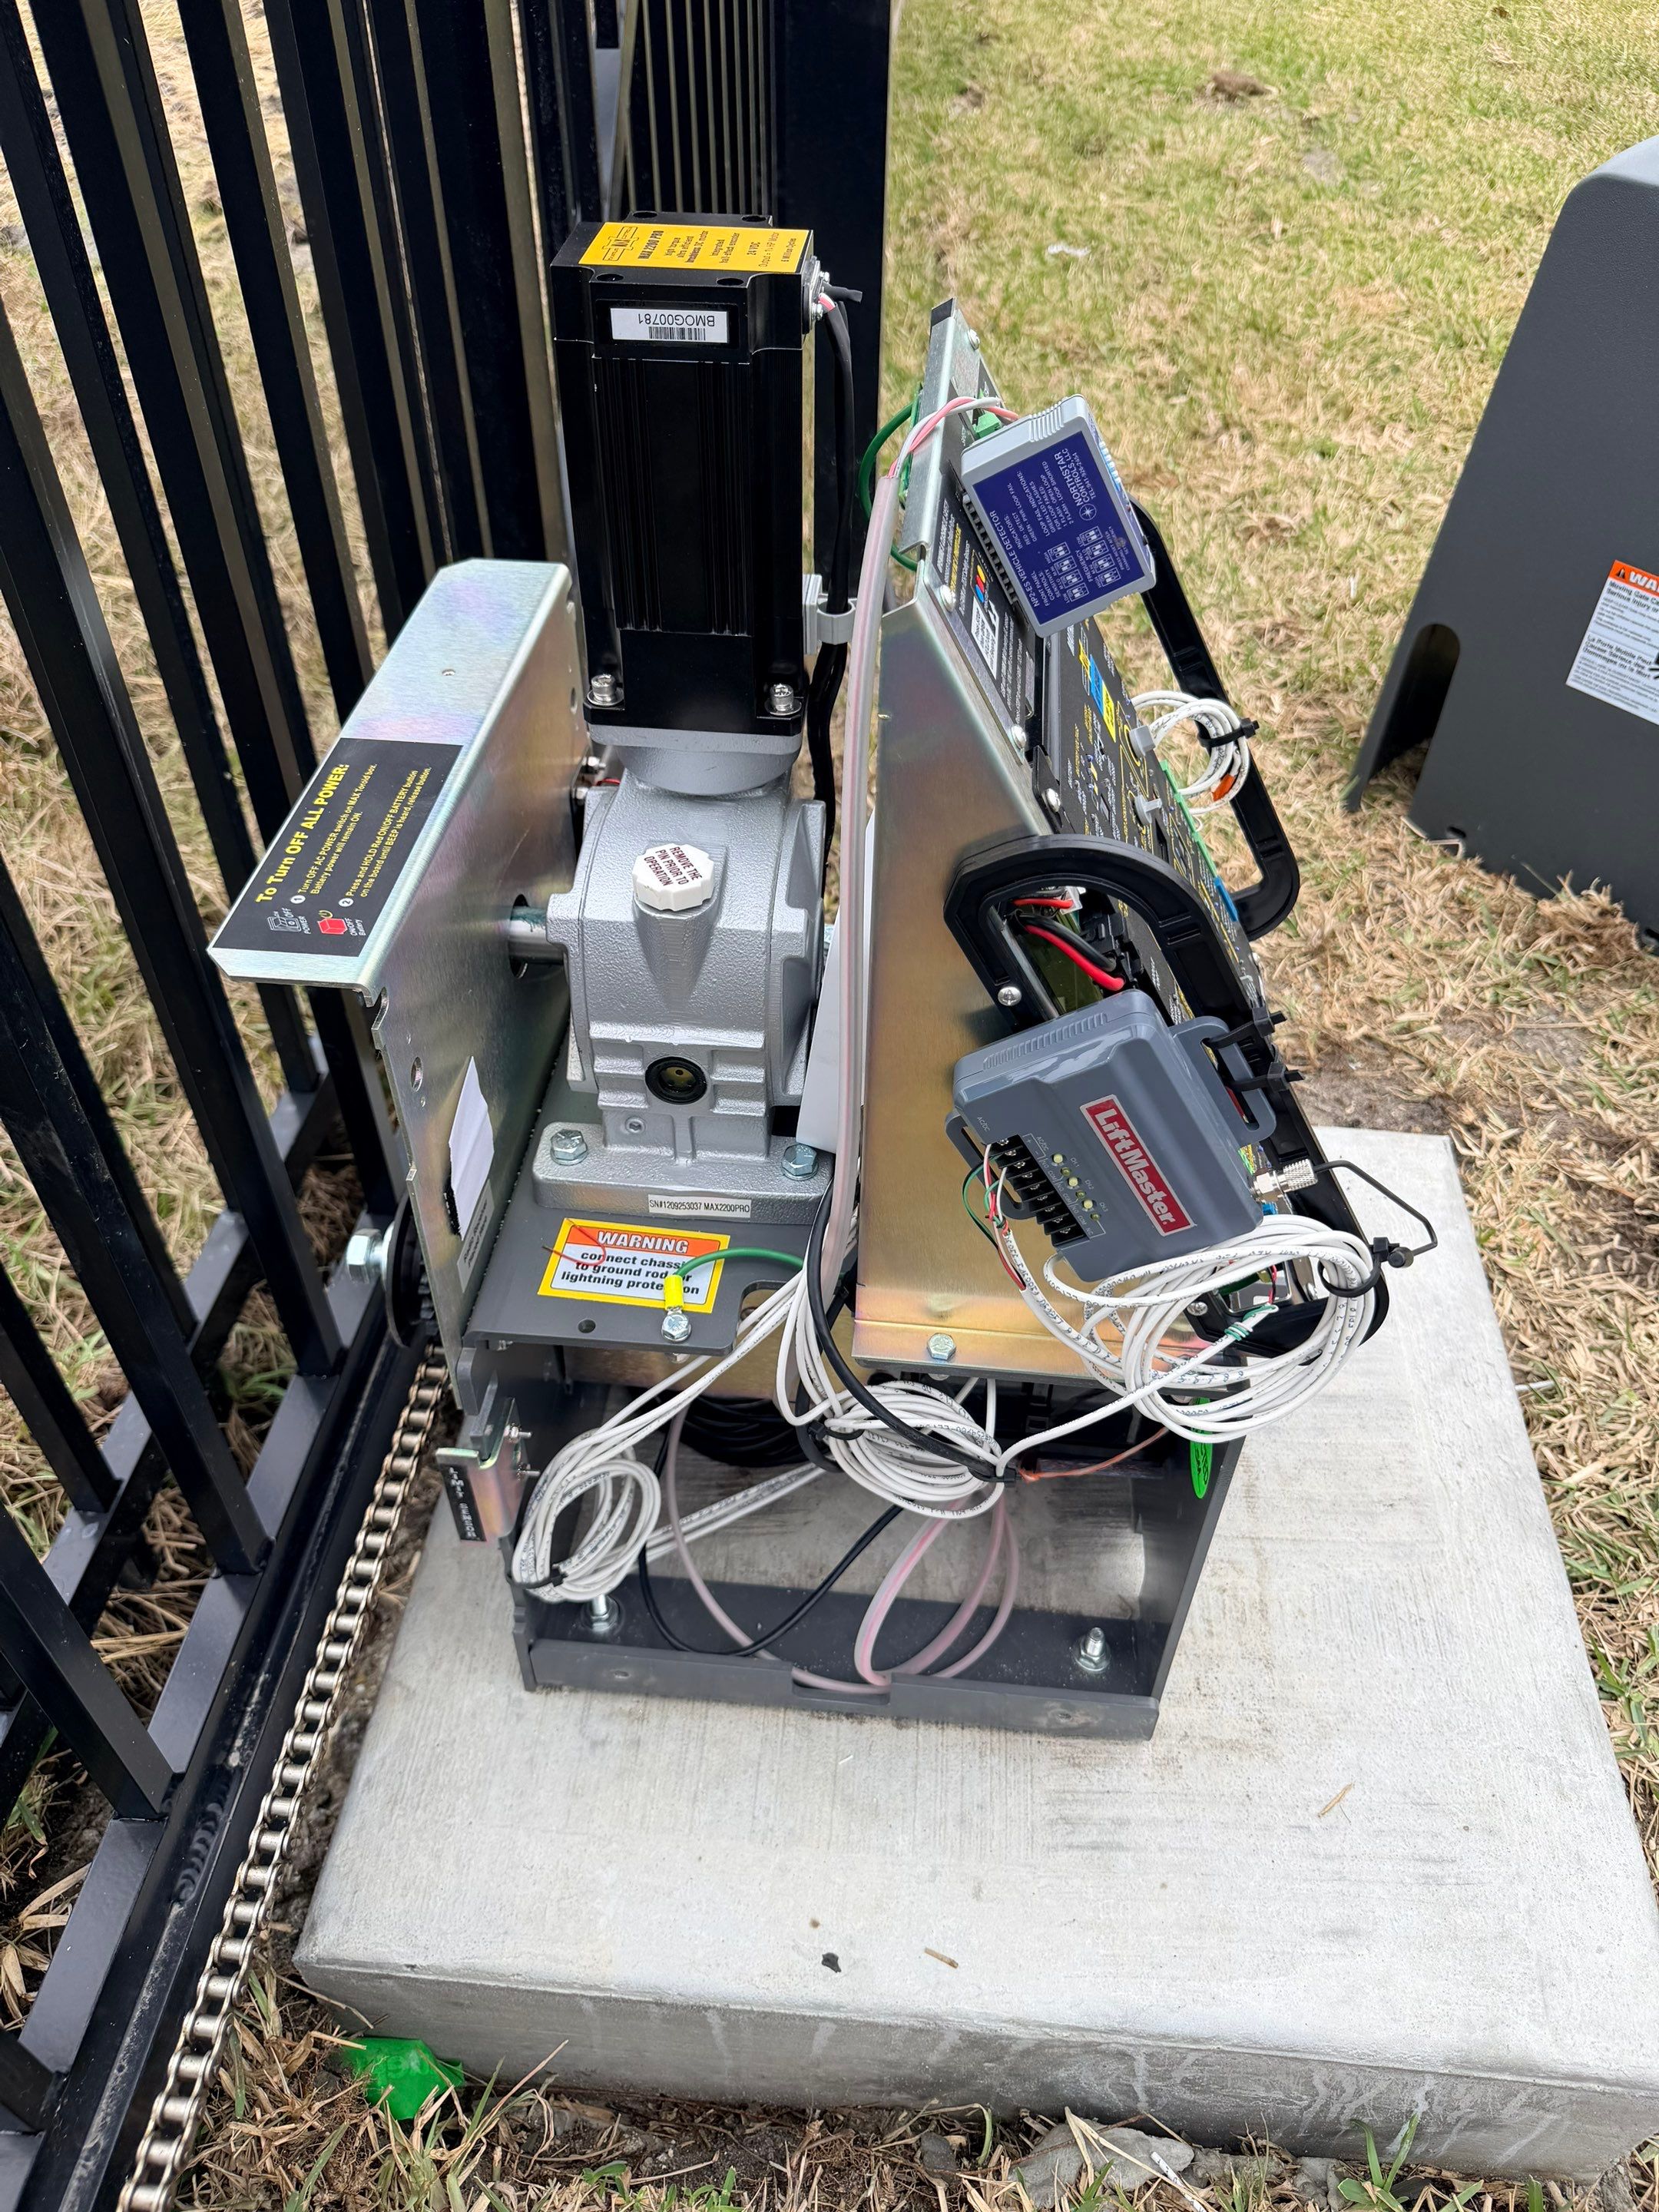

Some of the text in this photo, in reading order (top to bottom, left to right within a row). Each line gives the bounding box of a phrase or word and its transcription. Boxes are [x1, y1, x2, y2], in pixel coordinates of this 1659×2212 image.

[638, 313, 715, 327] BMOG00781
[1061, 447, 1071, 461] LLC
[1040, 473, 1050, 488] LOOP
[1053, 451, 1084, 506] NORTHSTAR
[1006, 482, 1015, 494] FAIL
[1046, 488, 1057, 503] OPEN
[1052, 485, 1063, 501] LOOP
[1012, 494, 1022, 508] LOOP
[1033, 508, 1042, 520] FAIL
[1047, 504, 1057, 518] LOOP
[1039, 520, 1050, 536] LOOP
[988, 509, 1040, 607] NP2-ES VEHICLE DETECTOR
[1075, 548, 1093, 582] FREQUENCY
[1029, 571, 1050, 606] FRONT PANEL
[1629, 571, 1659, 593] WA
[364, 763, 377, 774] box.
[415, 767, 432, 785] button.
[402, 770, 419, 787] button
[346, 793, 361, 805] MAX
[389, 787, 409, 813] BATTERY
[404, 785, 422, 805] release
[331, 813, 349, 832] switch
[376, 813, 396, 836] ON/OFF
[254, 763, 351, 902] To Turn OFF ALL POWER:
[339, 822, 357, 841] remain
[384, 829, 400, 845] BEEP
[318, 833, 339, 855] POWER
[333, 842, 346, 852] will
[371, 836, 384, 847] Red
[313, 856, 326, 865] AC
[361, 848, 378, 866] HOLD
[376, 846, 392, 859] until
[323, 853, 342, 871] power
[367, 859, 385, 877] board
[655, 849, 670, 860] PIN
[663, 859, 683, 878] PRIOR
[670, 846, 703, 881] REMOVE THE
[306, 865, 320, 877] OFF
[355, 866, 369, 877] and
[644, 856, 673, 886] OPERATION
[297, 879, 313, 892] Turn
[310, 872, 332, 893] Battery
[345, 879, 363, 896] Press
[362, 878, 376, 888] the
[358, 889, 370, 897] on
[282, 907, 293, 918] OFF
[298, 916, 311, 934] POWER
[649, 1199, 750, 1214] SN#1209253037 MAX2200PRO
[598, 1230, 689, 1253] WARNING
[581, 1252, 687, 1270] connect chassi
[593, 1266, 641, 1277] ground
[645, 1270, 668, 1280] rod
[561, 1271, 700, 1295] lightning proteon
[449, 1468, 477, 1538] LIMIT SENSOR
